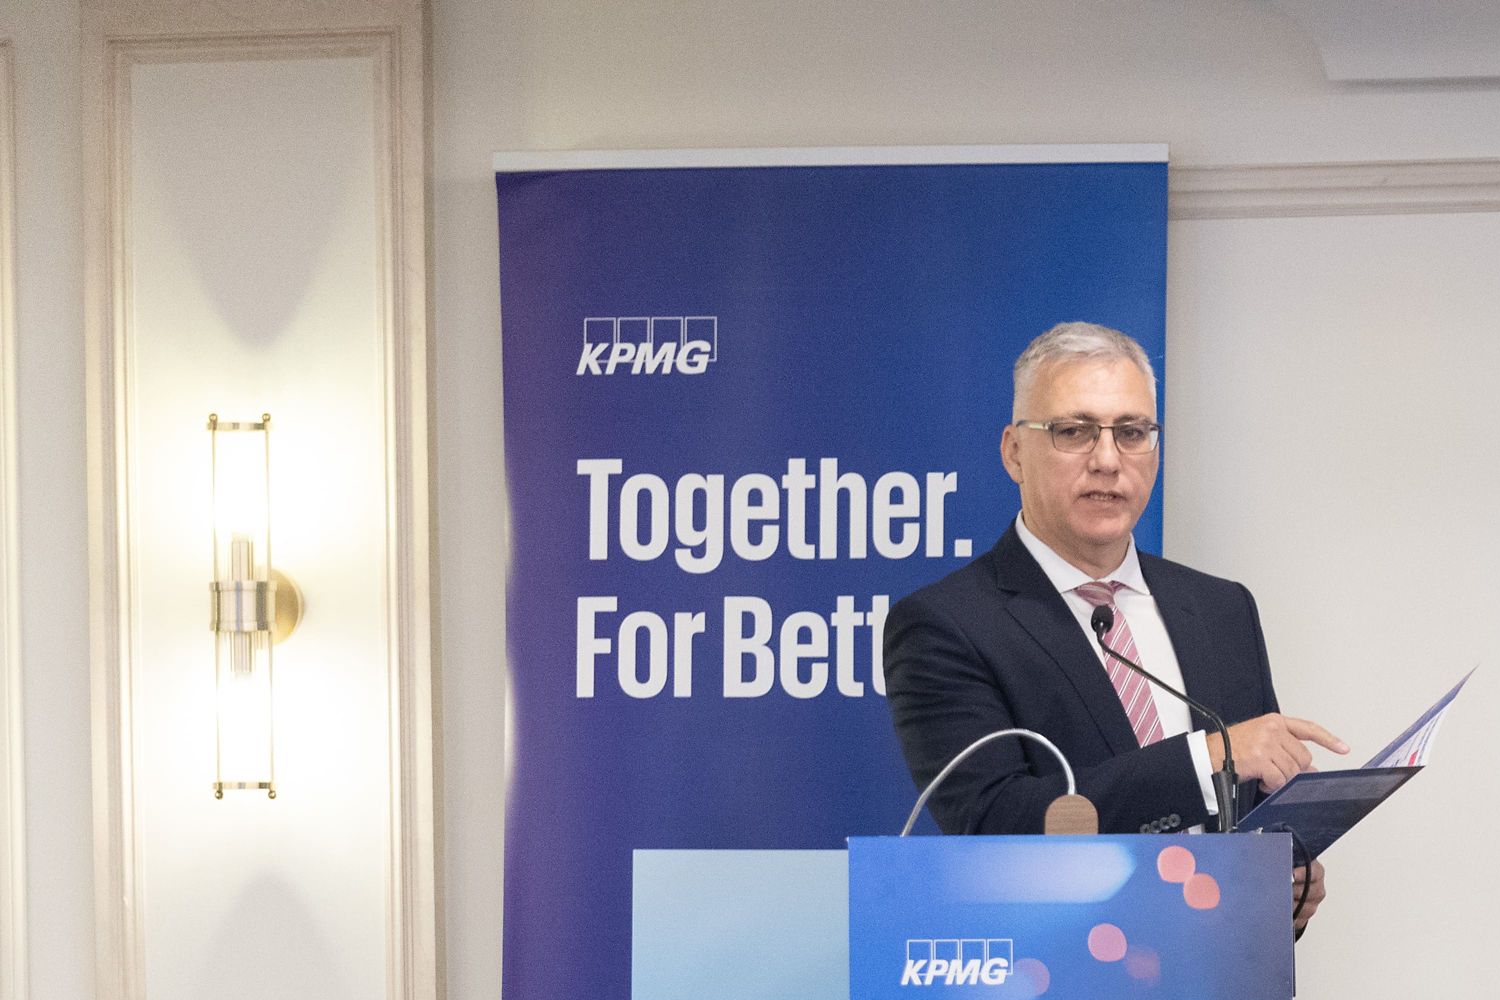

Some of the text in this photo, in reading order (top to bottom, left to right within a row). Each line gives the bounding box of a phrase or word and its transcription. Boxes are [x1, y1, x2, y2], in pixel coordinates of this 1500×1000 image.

[576, 340, 711, 375] KPMG
[576, 457, 973, 574] Together.
[576, 594, 887, 699] For Bett
[901, 958, 1009, 986] KPMG
